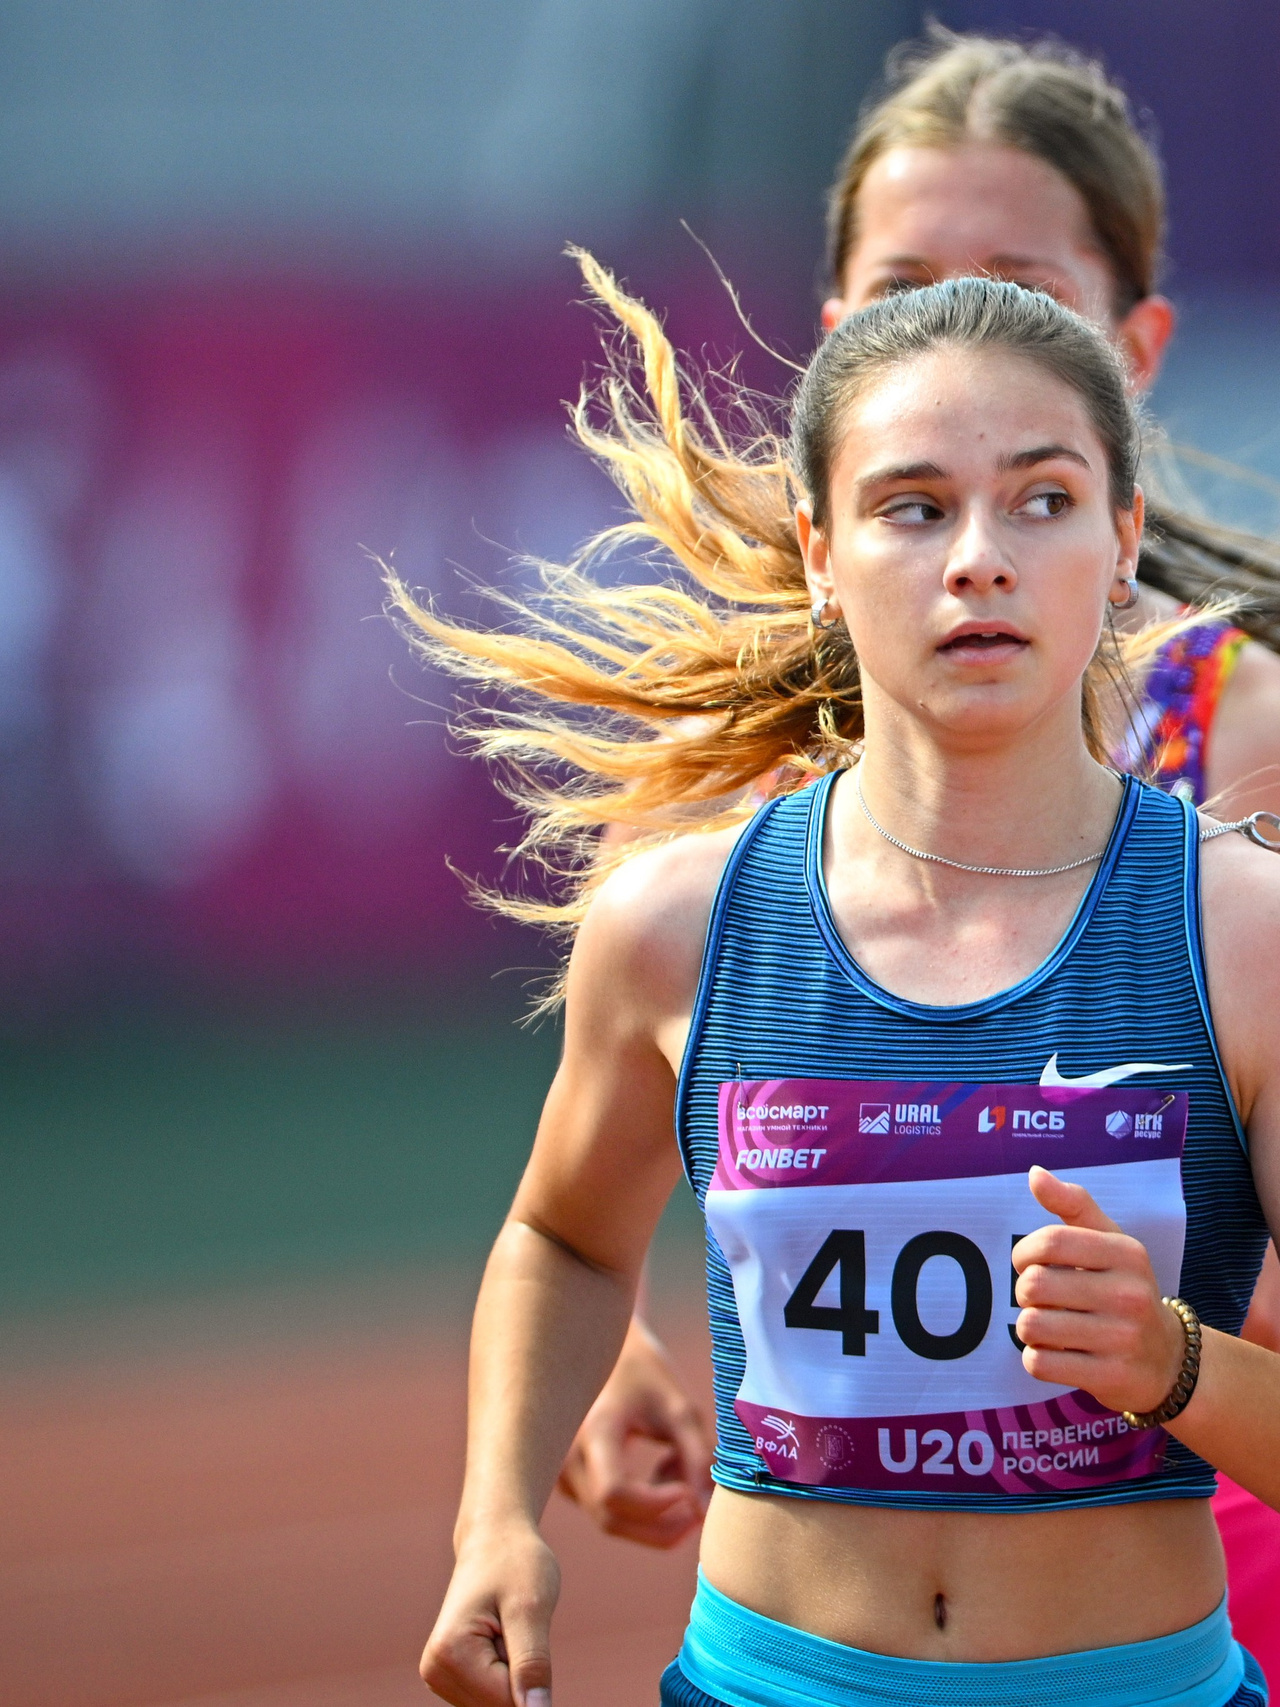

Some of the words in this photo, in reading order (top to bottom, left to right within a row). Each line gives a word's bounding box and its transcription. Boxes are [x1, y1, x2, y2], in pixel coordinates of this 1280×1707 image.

[895, 1104, 942, 1124] URAL
[1012, 1110, 1065, 1130] ПСБ
[894, 1125, 942, 1135] LOGISTICS
[735, 1148, 828, 1170] FONBET
[784, 1229, 1024, 1361] 40
[1002, 1415, 1140, 1450] ПЕРВЕНСТВ
[756, 1436, 798, 1460] ВФЛА
[877, 1427, 996, 1476] U20
[1003, 1447, 1100, 1475] РОССИИ
